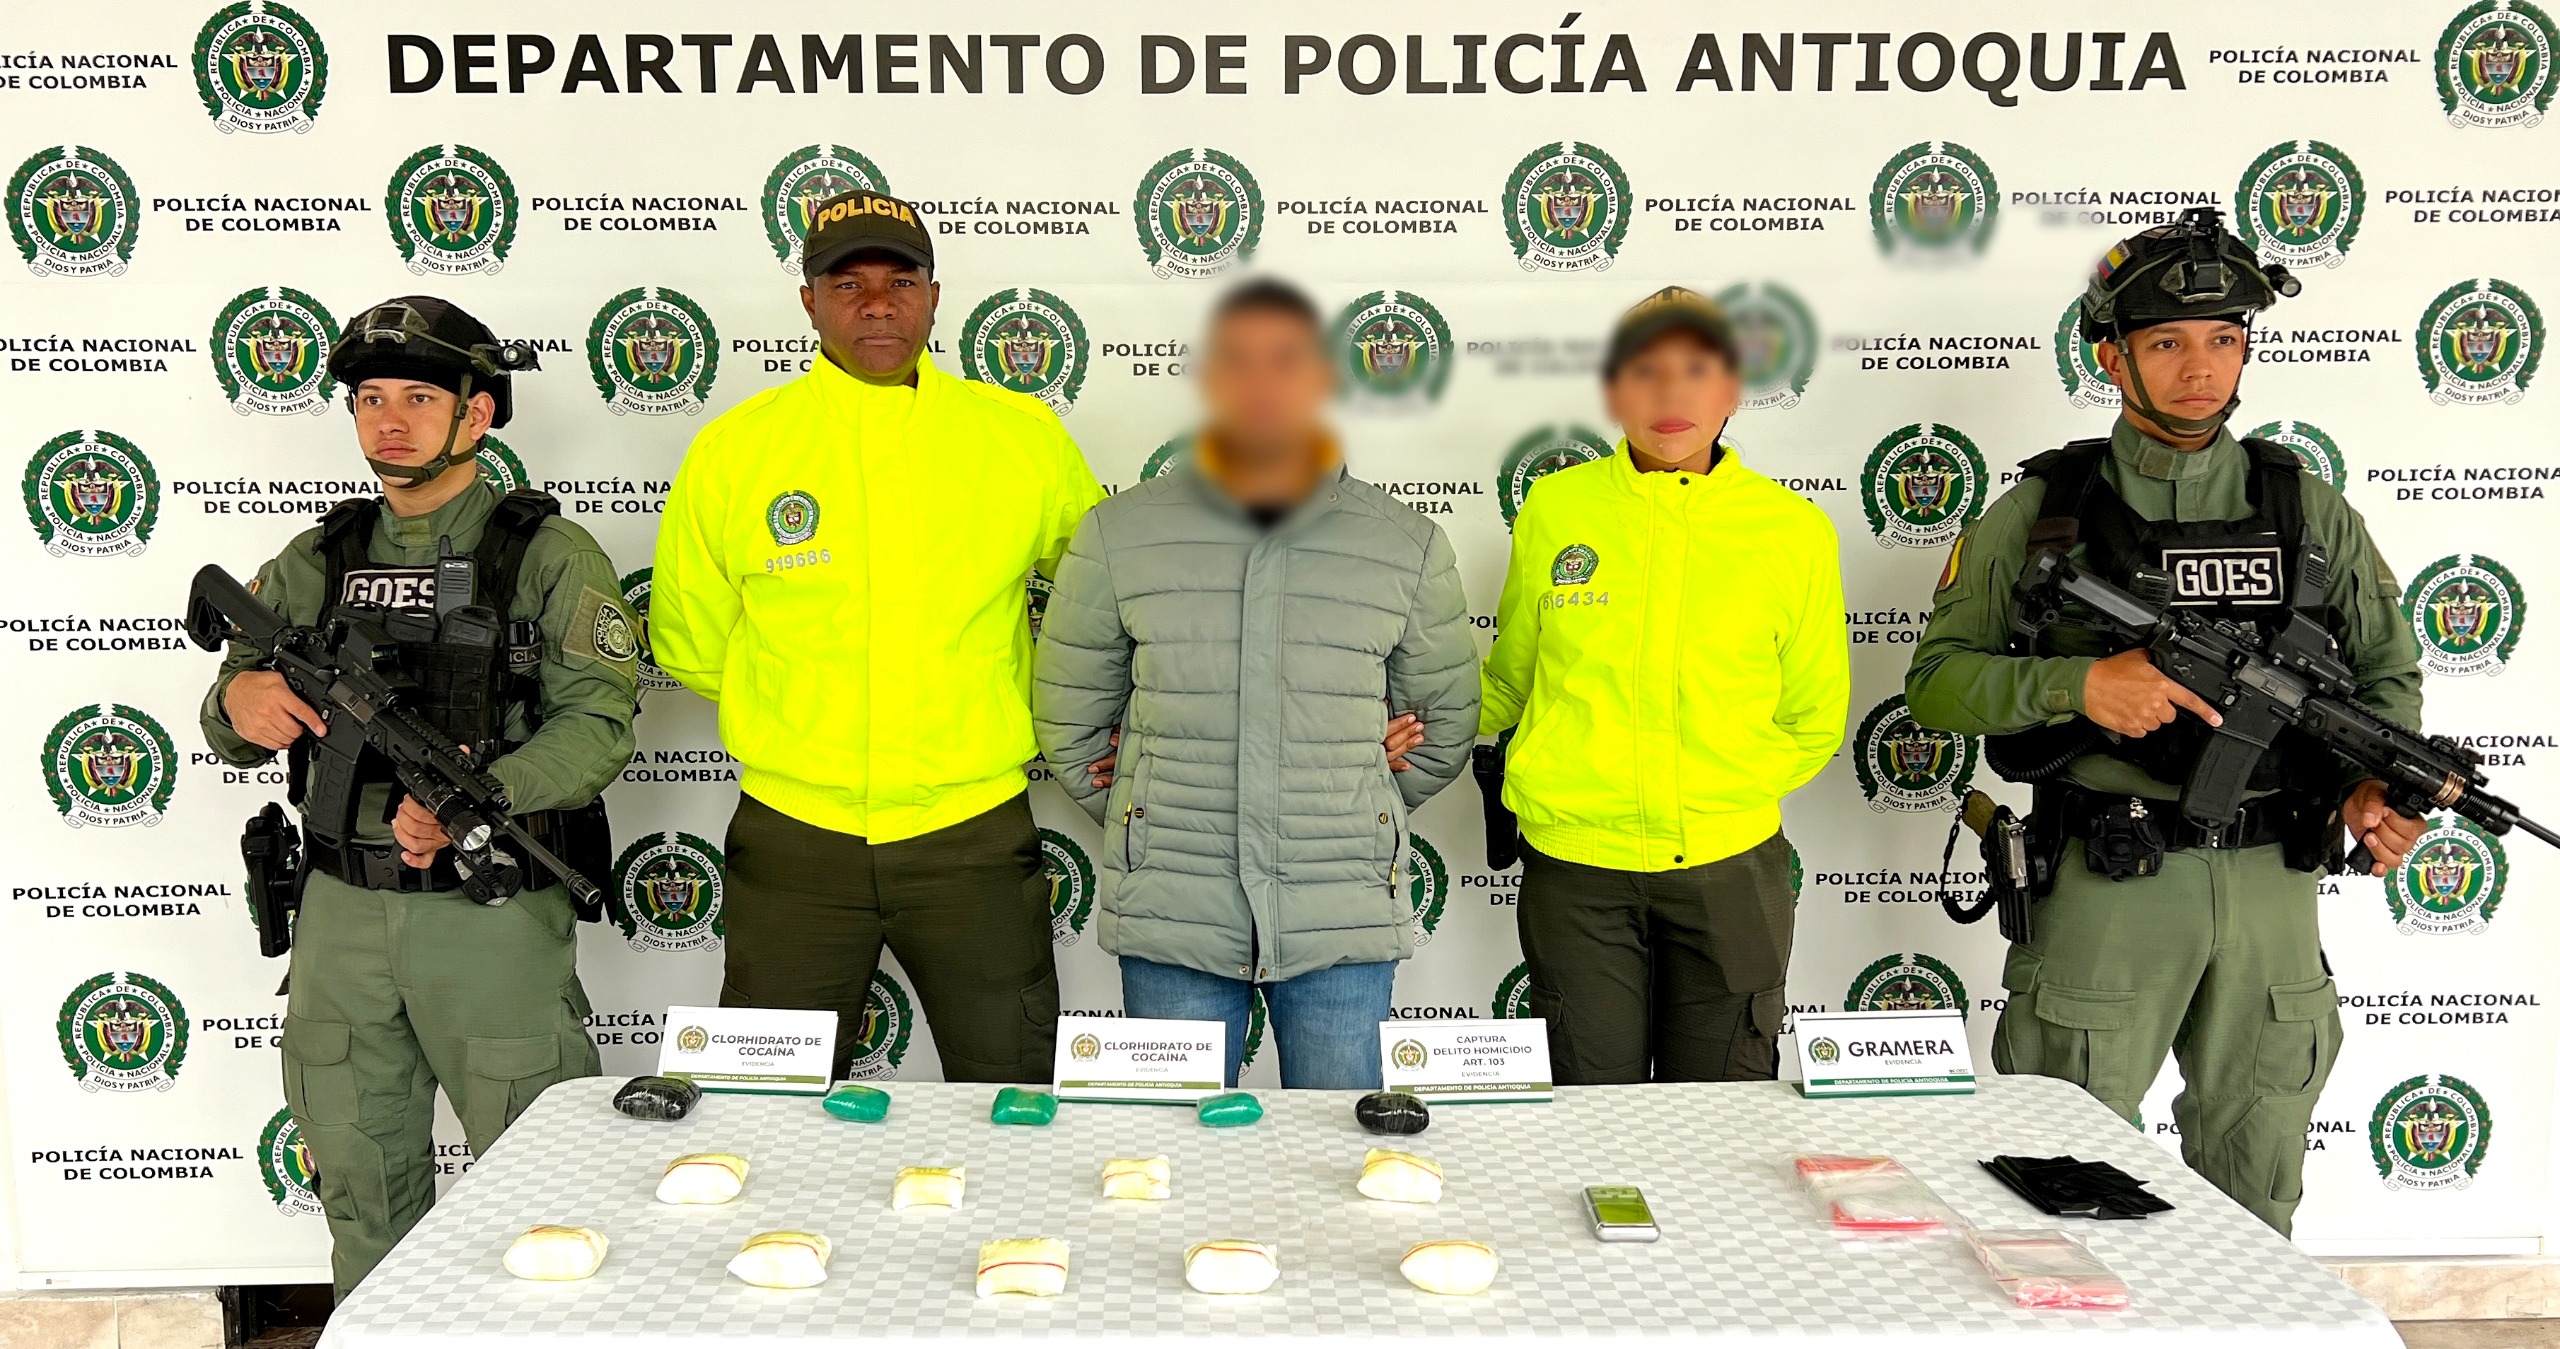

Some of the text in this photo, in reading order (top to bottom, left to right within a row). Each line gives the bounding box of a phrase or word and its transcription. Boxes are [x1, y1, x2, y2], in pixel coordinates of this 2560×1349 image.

[251, 14, 268, 24] DE
[277, 21, 313, 76] COLOMBIA
[0, 50, 178, 69] ICÍA NACIONAL
[387, 12, 2187, 108] DEPARTAMENTO DE POLICÍA ANTIOQUIA
[2209, 45, 2421, 64] POLICÍA NACIONAL
[28, 75, 147, 90] COLOMBIA
[2238, 69, 2389, 84] DE COLOMBIA
[263, 85, 309, 119] NACIONAL
[228, 114, 254, 131] DIOS
[263, 114, 300, 131] PATRIA
[532, 192, 748, 212] POLICÍA NACIONAL
[2012, 187, 2222, 205] POLICÍA NACIONAL
[2385, 185, 2560, 204] POLICÍA NACIO
[153, 193, 372, 213] POLICÍA NACIONAL
[1006, 201, 1121, 215] NACIONAL
[1277, 196, 1489, 215] POLICÍA NACIONAL
[1645, 193, 1856, 212] POLICÍA NACIONAL
[817, 195, 917, 232] POLICIA
[2413, 209, 2560, 223] DE COLOMBIA
[185, 217, 341, 232] DE COLOMBIA
[564, 217, 718, 231] DE COLOMBIA
[938, 221, 1090, 235] DE COLOMBIA
[1307, 220, 1458, 234] DE COLOMBIA
[1675, 217, 1825, 232] DE COLOMBIA
[0, 334, 197, 353] LICÍA NACIONAL
[1929, 336, 2041, 350] NACIONAL
[2291, 329, 2402, 343] NACIONAL
[1861, 356, 2010, 370] DE COLOMBIA
[2257, 349, 2371, 363] COLOMBIA
[11, 358, 168, 372] DE COLOMBIA
[764, 359, 792, 373] DE
[1133, 363, 1160, 376] DE
[2367, 464, 2560, 482] POLICÍA NACIONA
[172, 477, 384, 495] POLICÍA NACIONAL
[544, 476, 636, 495] POLICÍA
[2396, 486, 2544, 501] DE COLOMBIA
[204, 500, 337, 515] DE COLOMB
[575, 500, 604, 514] DE
[765, 548, 832, 574] 919686
[2175, 557, 2274, 597] GOES
[2459, 567, 2474, 576] DE
[2482, 572, 2510, 623] COLOMBIA
[99, 618, 188, 633] NACION
[29, 637, 188, 652] DE COLOMBIA
[1852, 630, 1879, 644] DE
[2458, 631, 2507, 663] NACIONAL
[2426, 659, 2450, 674] DIOS
[2458, 658, 2493, 674] PATRIA
[222, 770, 250, 785] DE
[622, 768, 738, 783] COLOMBIA
[1460, 874, 1523, 888] POLIC
[1815, 868, 1989, 886] POLICÍA NACION
[12, 882, 232, 901] POLICÍA NACIONAL
[1844, 890, 1871, 904] DE
[1490, 893, 1517, 906] DE
[46, 903, 201, 918] DE COLOMBIA
[2339, 990, 2541, 1008] POLICÍA NACIONAL
[582, 1009, 656, 1027] OLICÍA
[1389, 1006, 1480, 1020] ACIONAL
[2365, 1012, 2509, 1025] DE COLOMBIA
[234, 1036, 263, 1049] DE
[596, 1032, 623, 1046] DE
[712, 1035, 821, 1046] CLORHIDRATO DE
[1105, 1041, 1192, 1050] CLORHIDRATO
[1457, 1035, 1506, 1044] CAPTURA
[739, 1045, 795, 1056] COCAÍNA
[1131, 1051, 1188, 1061] COCAÍNA
[1434, 1046, 1531, 1055] DELITO HOMICIDIO
[1848, 1040, 1955, 1057] GRAMERA
[1463, 1058, 1505, 1066] ART. 103
[31, 1145, 244, 1164] POLICÍA NACIONAL
[64, 1166, 214, 1181] DE COLOMBIA
